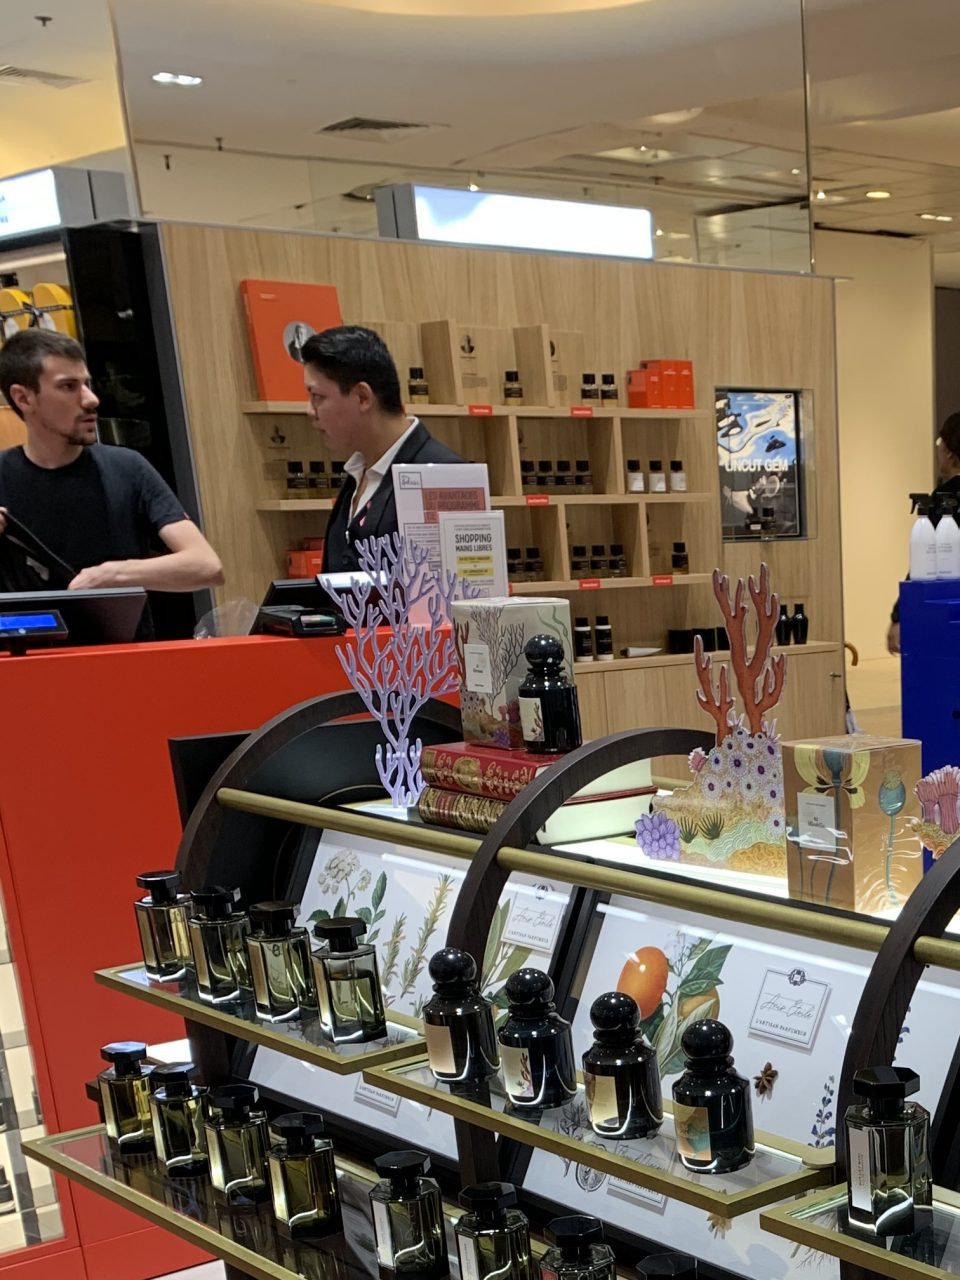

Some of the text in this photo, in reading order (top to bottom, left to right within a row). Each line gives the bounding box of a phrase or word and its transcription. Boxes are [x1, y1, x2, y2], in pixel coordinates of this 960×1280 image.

[725, 458, 789, 472] UNCUT GEM
[455, 533, 492, 544] SHOPPING
[473, 544, 493, 552] LIBRES
